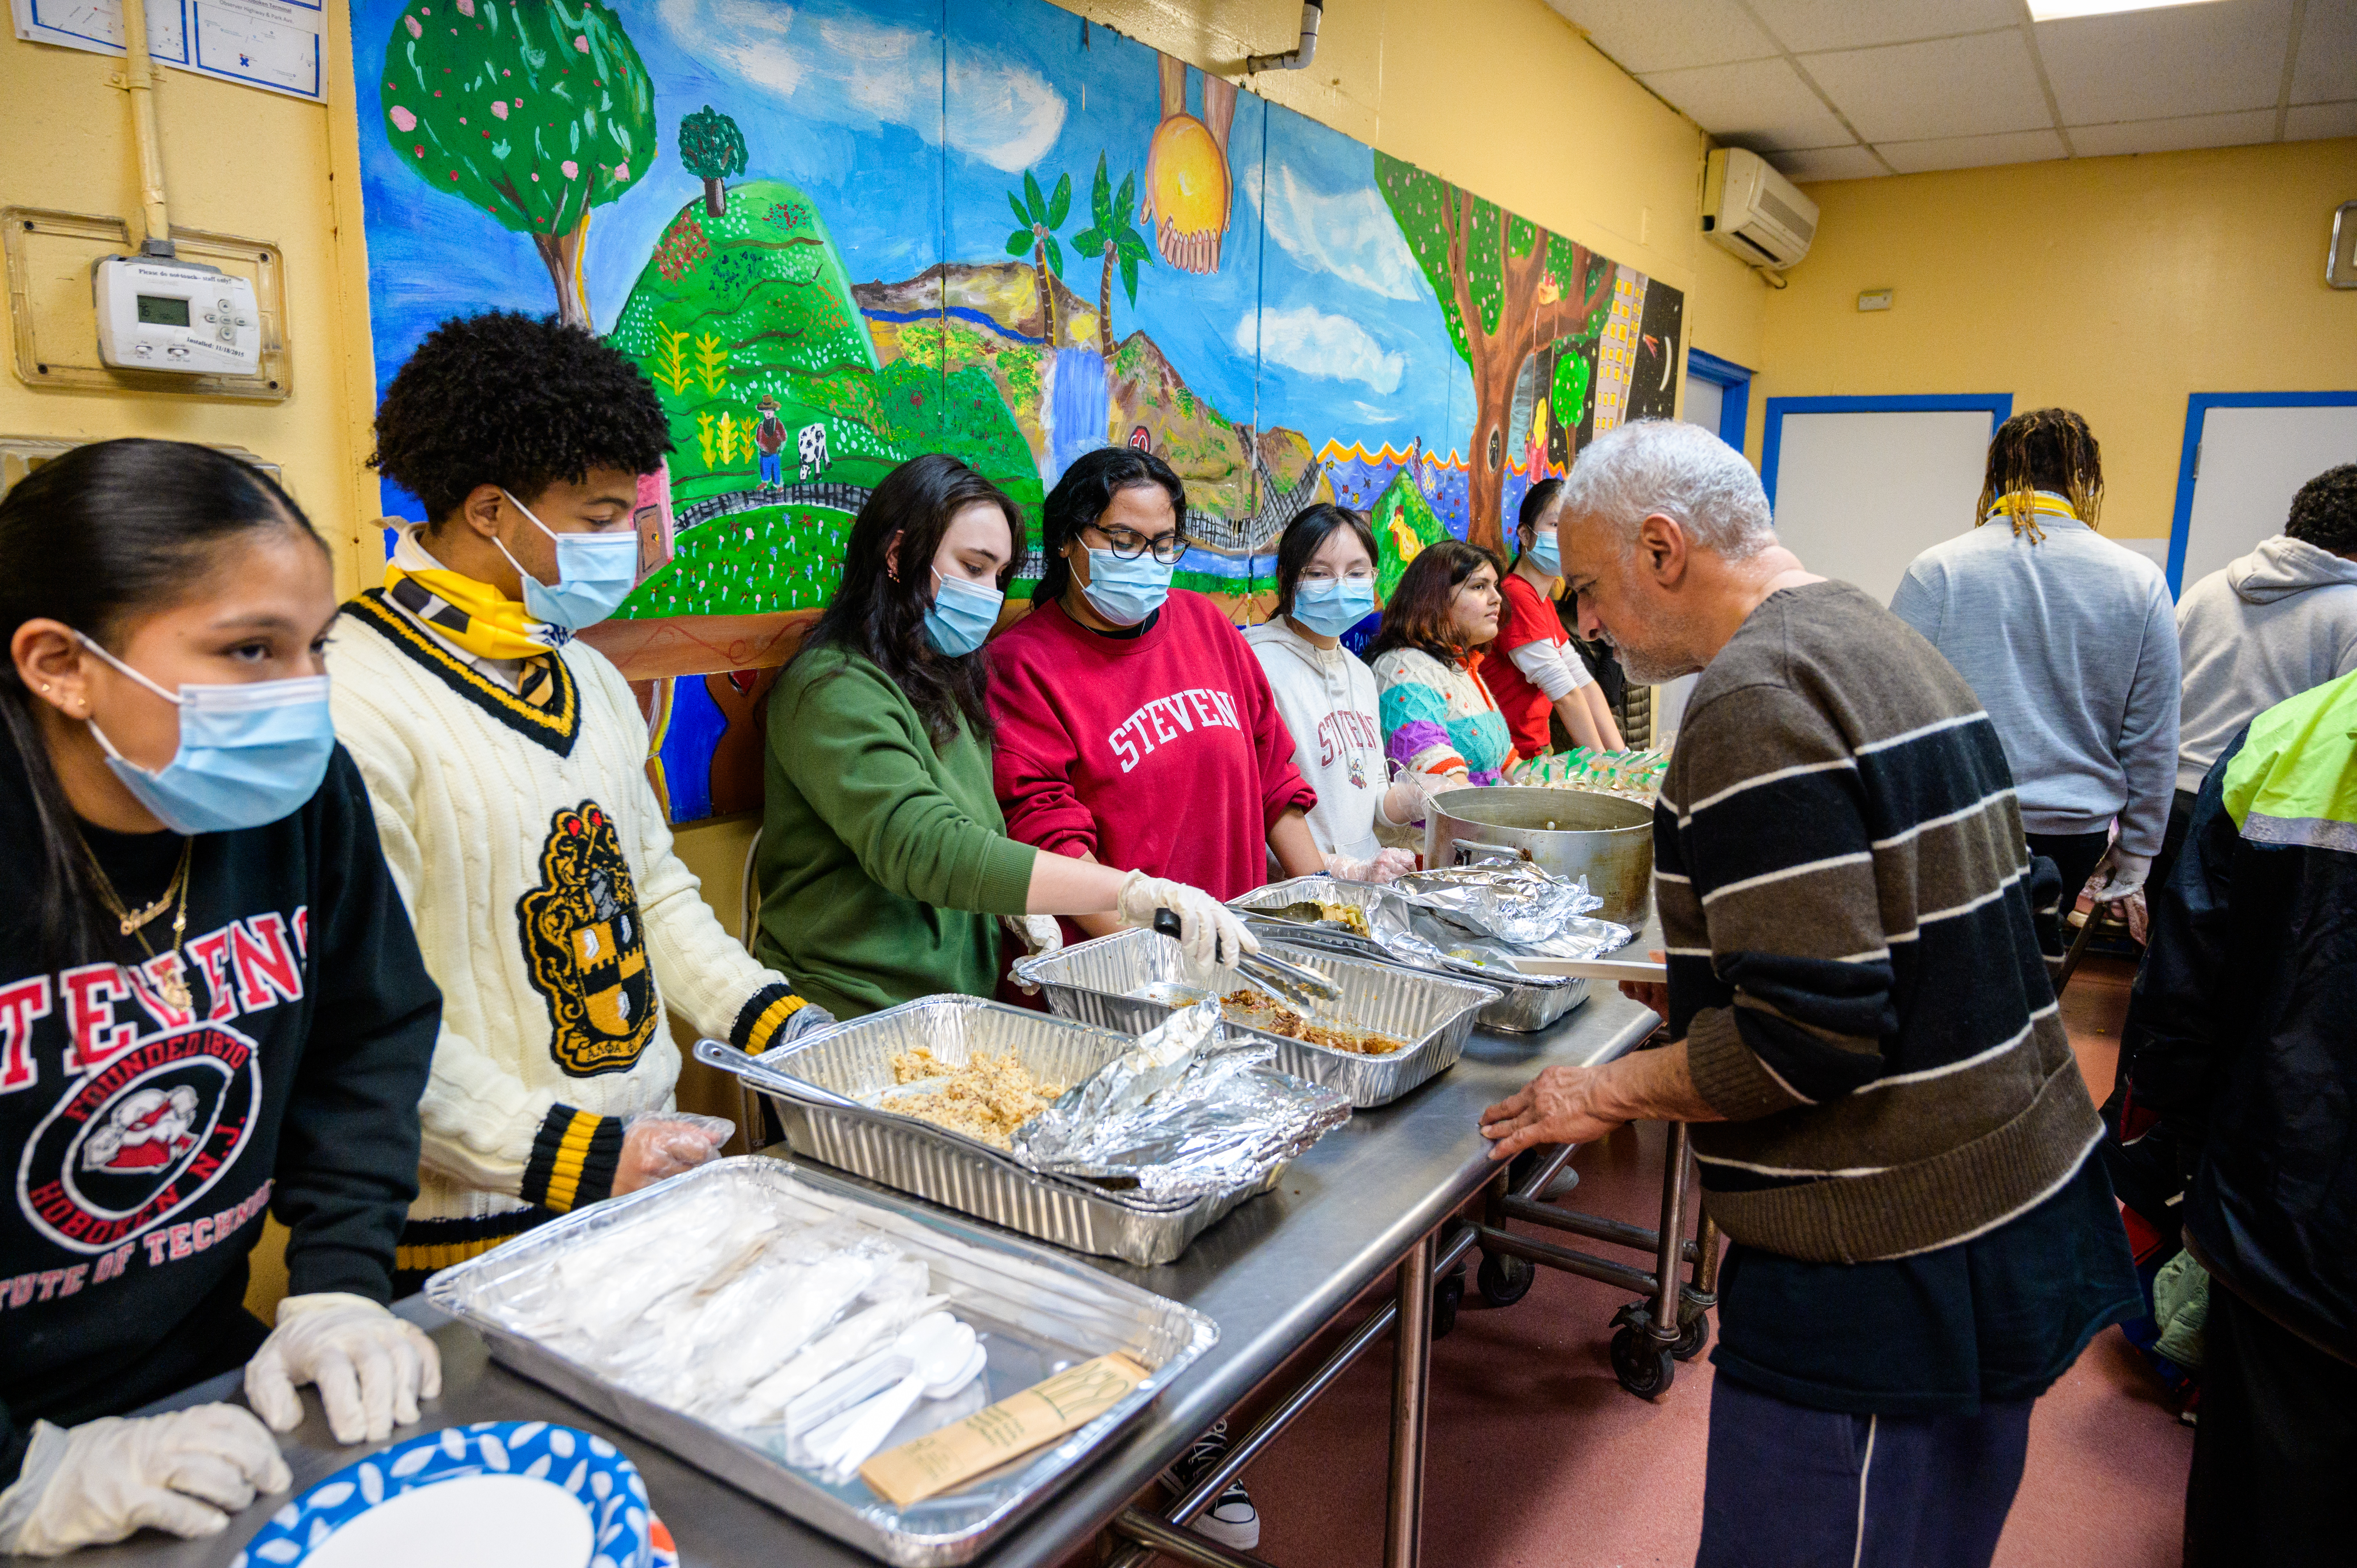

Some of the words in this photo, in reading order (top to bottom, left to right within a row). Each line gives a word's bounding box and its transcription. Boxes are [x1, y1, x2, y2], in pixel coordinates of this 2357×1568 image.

[219, 0, 242, 10] Observer
[244, 7, 265, 16] Highway
[269, 3, 292, 12] Terminal
[187, 337, 214, 349] Installed:
[216, 345, 244, 357] 11/18/2015
[1108, 689, 1244, 773] STEVEN
[64, 1031, 201, 1122] FOUNDED
[203, 1029, 251, 1070] 1870
[29, 1180, 182, 1244] HOBOKEN
[92, 1241, 136, 1284] OF
